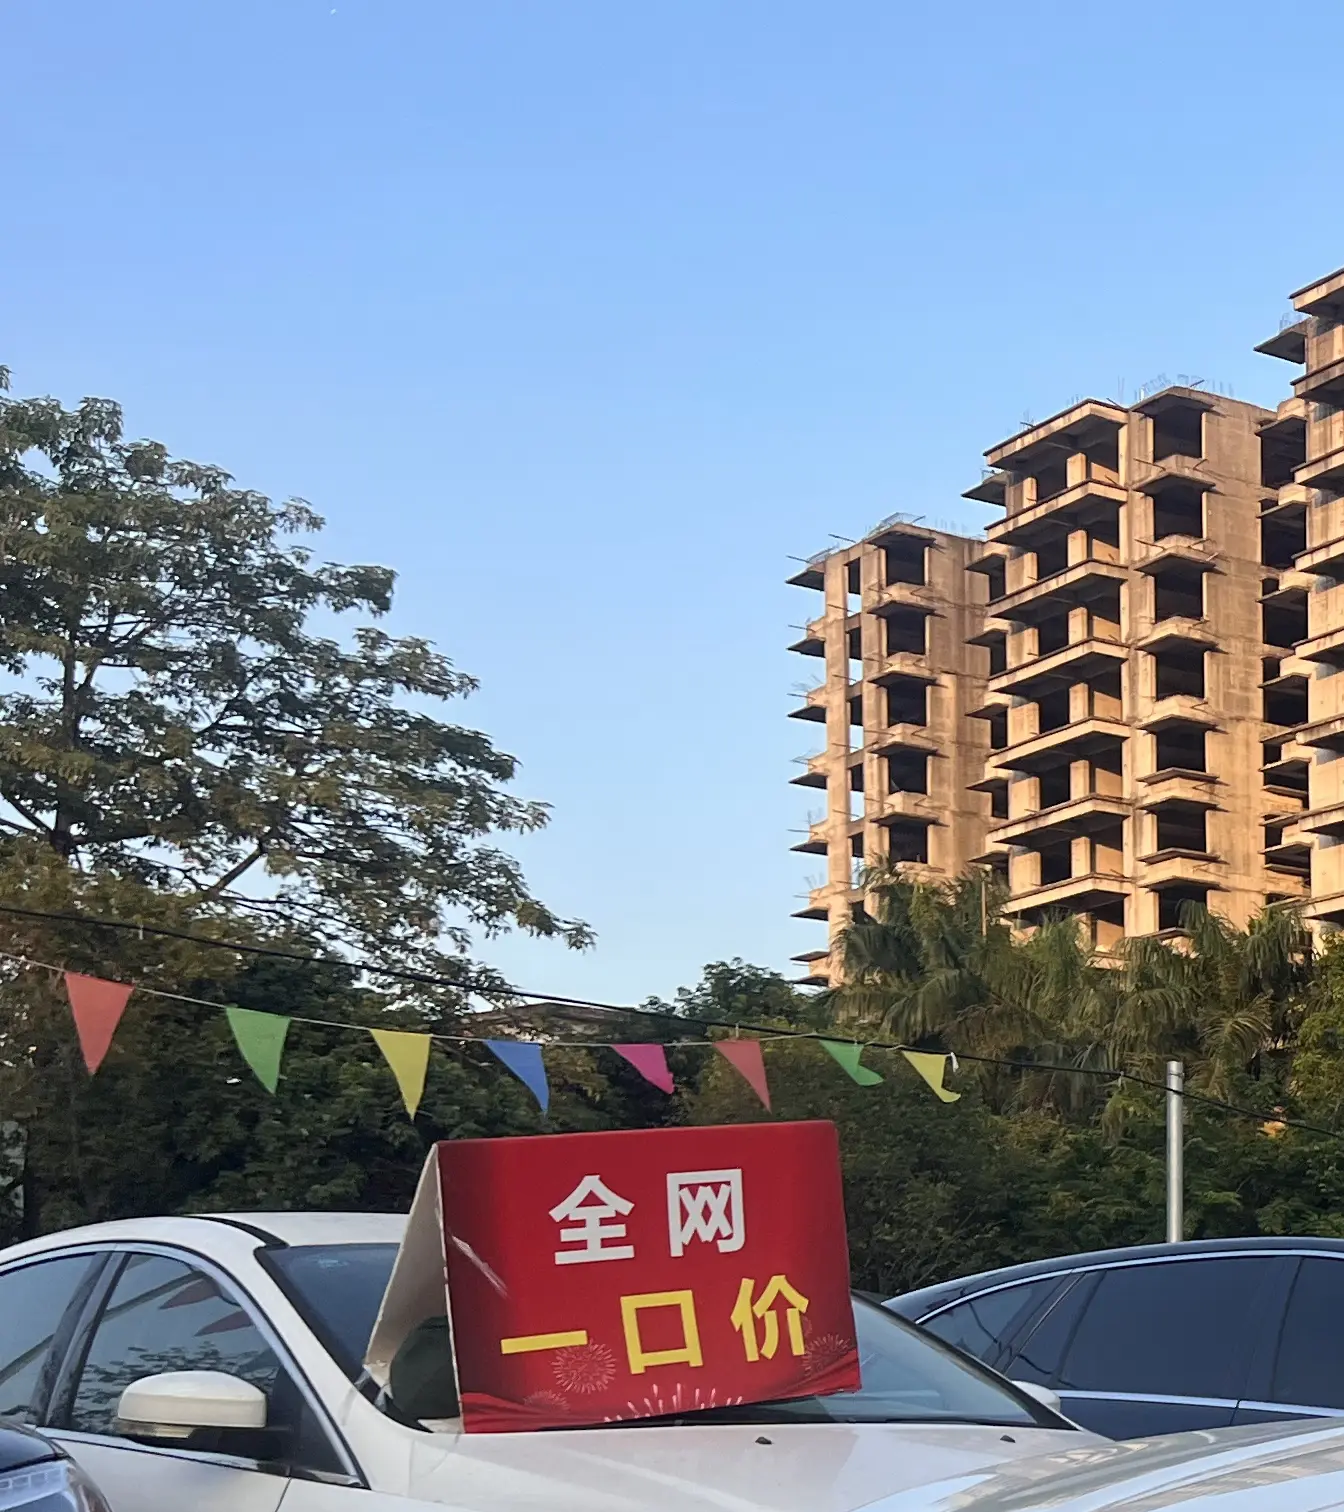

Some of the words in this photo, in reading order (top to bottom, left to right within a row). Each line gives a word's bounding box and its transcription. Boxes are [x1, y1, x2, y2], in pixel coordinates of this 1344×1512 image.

[548, 1167, 746, 1266] 全网
[500, 1274, 810, 1375] 一口价
